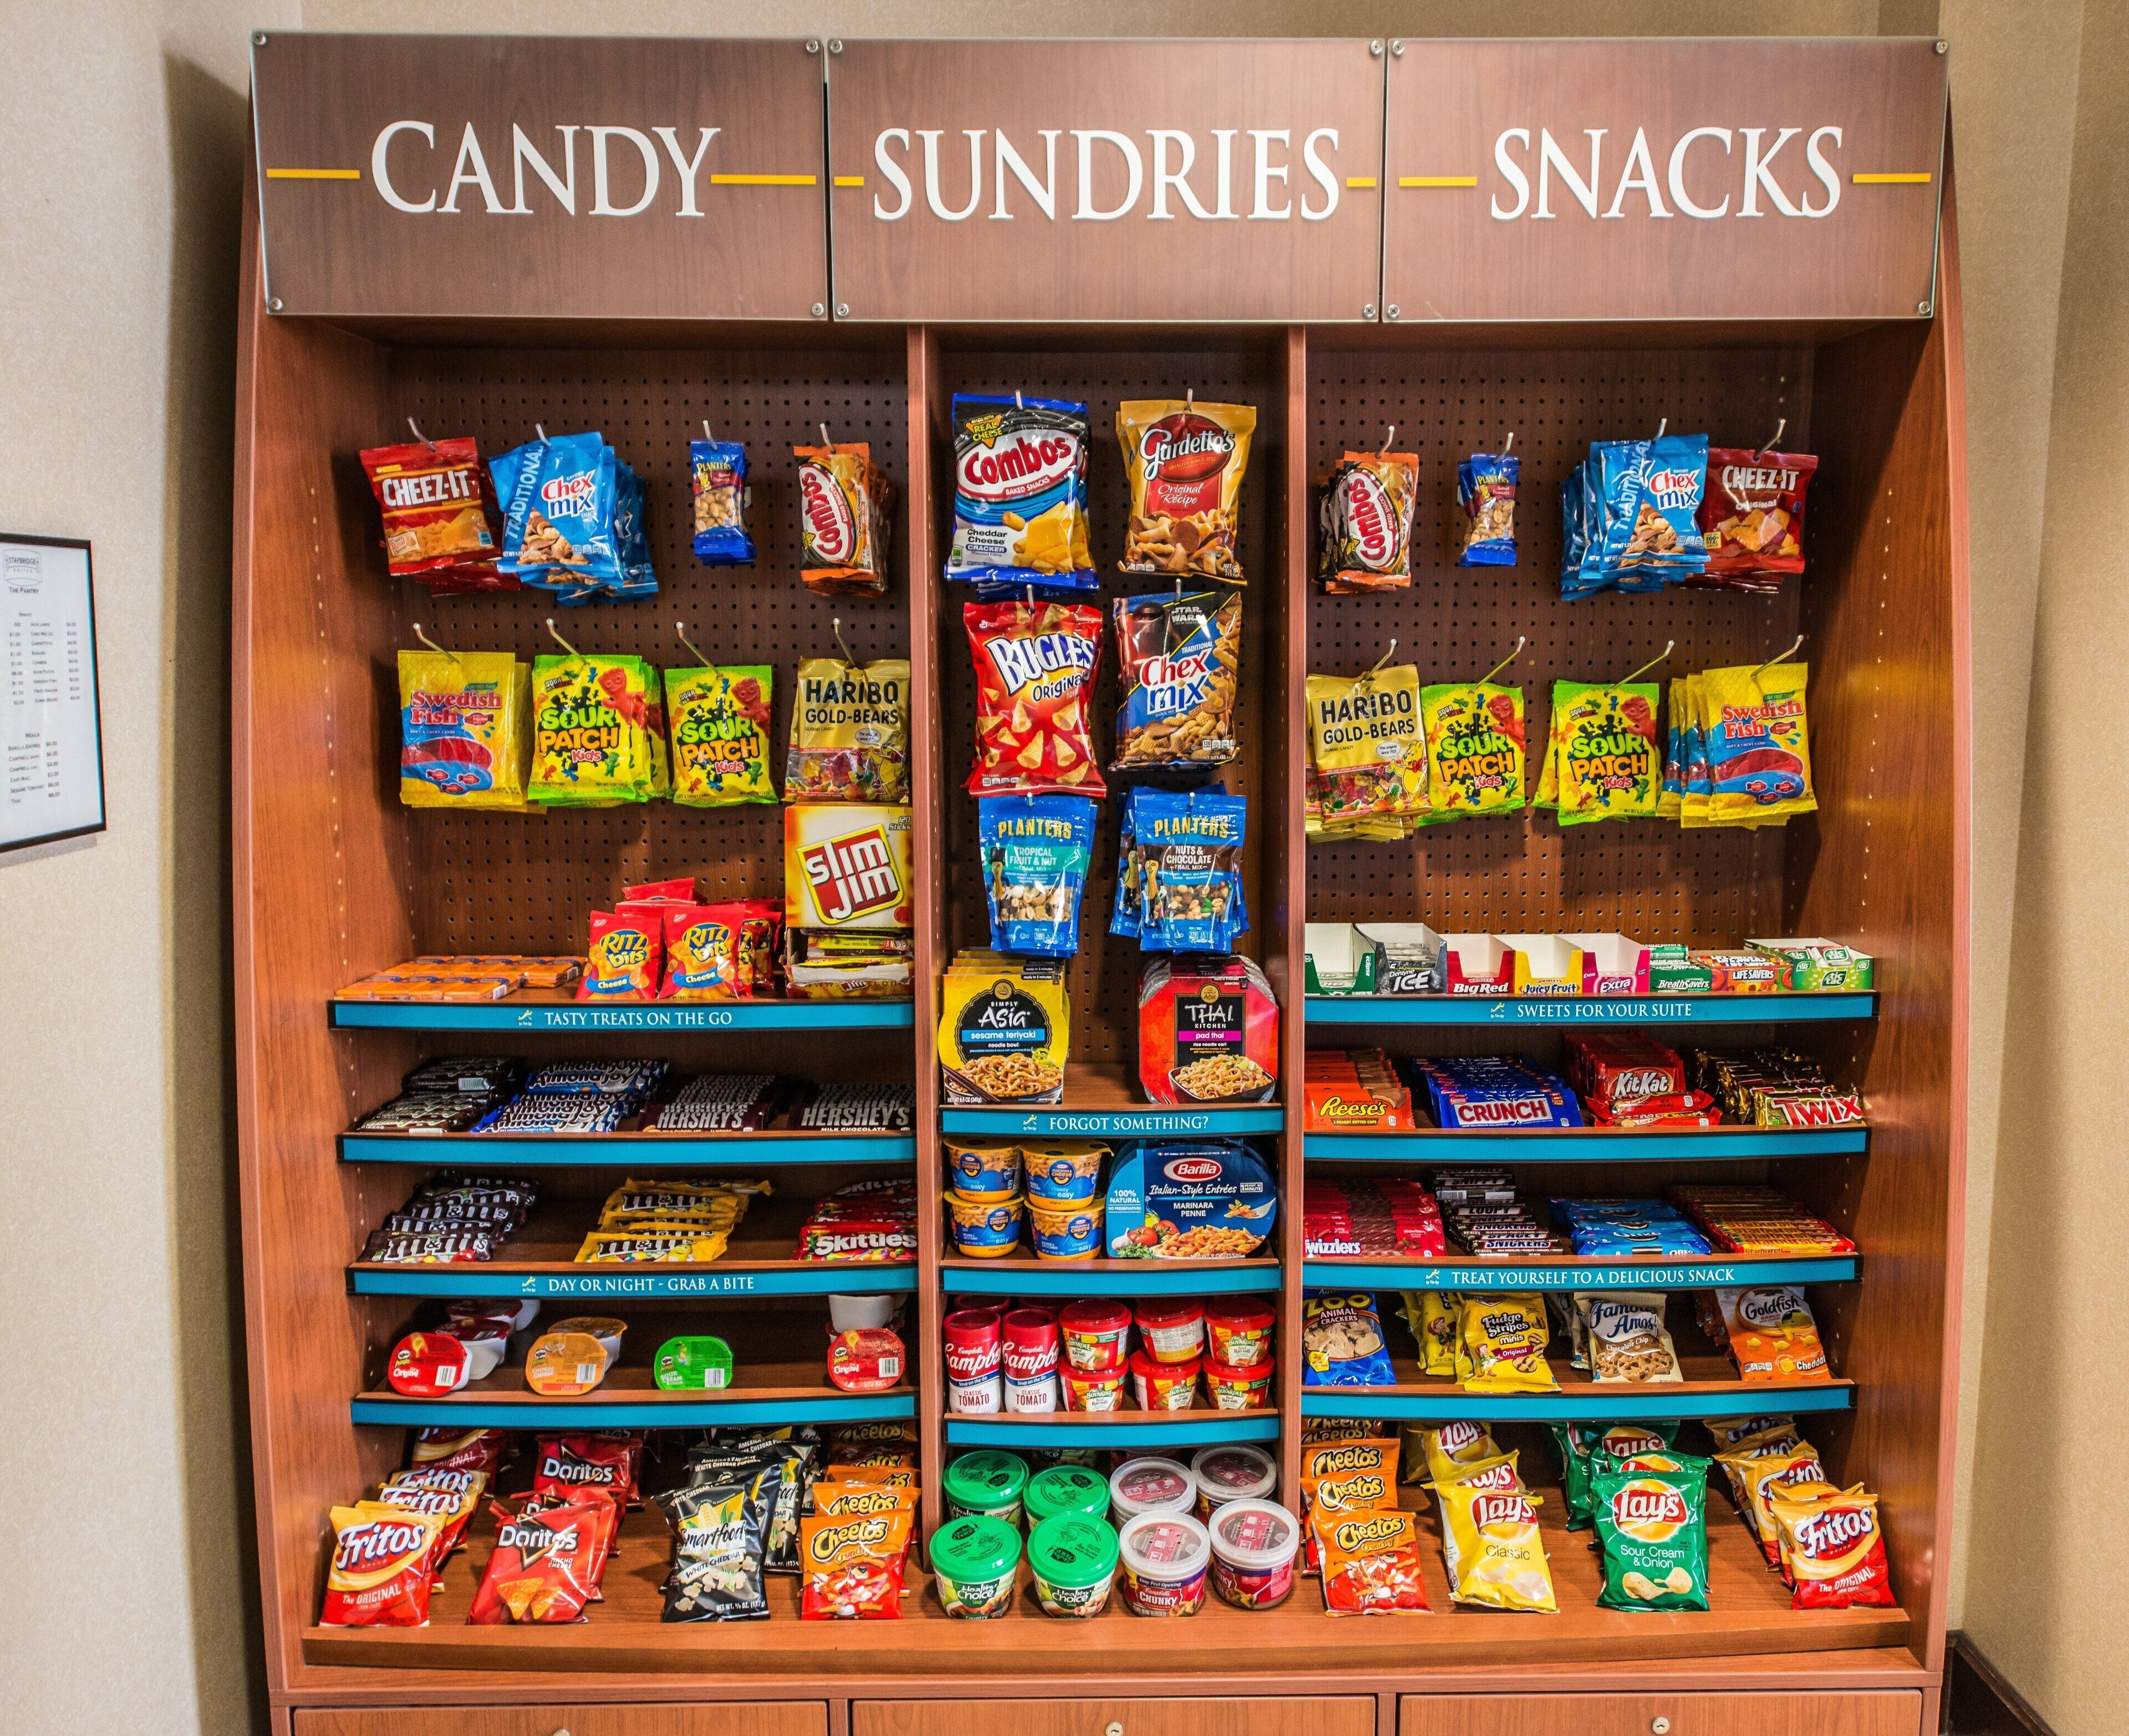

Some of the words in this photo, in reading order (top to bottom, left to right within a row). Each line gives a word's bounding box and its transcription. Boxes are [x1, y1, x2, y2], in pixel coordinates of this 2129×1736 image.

[371, 121, 721, 216] CANDY
[874, 128, 1341, 221] SUNDRIES
[1491, 125, 1842, 220] SNACKS
[972, 428, 1002, 441] CHEESE
[974, 422, 999, 434] REAL
[964, 435, 1068, 485] Combos
[1140, 429, 1236, 480] Gardetto's
[696, 462, 731, 472] PLANTERS
[383, 470, 471, 506] CHEEZ-IT
[505, 445, 544, 538] TRADITIONAL
[542, 470, 595, 500] Chex
[1158, 483, 1203, 496] Original
[549, 492, 594, 518] mix
[1164, 495, 1198, 506] Recipe
[802, 472, 843, 556] Combos
[967, 529, 1007, 538] Cheddar
[967, 536, 1005, 545] Cheese
[8, 557, 35, 565] STAYBRIDGE
[1172, 606, 1201, 615] STAR
[986, 634, 1094, 695] BUGLES
[544, 678, 562, 688] SOUR
[411, 690, 502, 708] Swedish
[806, 679, 899, 705] HARIBO
[1321, 689, 1412, 725] HARIBO
[410, 707, 458, 726] Fish
[804, 708, 899, 725] GOLD-BEARS
[538, 727, 618, 754] PATCH
[572, 749, 601, 762] Kids
[1015, 847, 1052, 857] TROPICAL
[1175, 846, 1194, 856] NUTS
[1196, 847, 1203, 855] &
[805, 837, 889, 886] slim
[1010, 856, 1031, 865] FRUIT
[1041, 857, 1057, 866] NUT
[1167, 854, 1211, 865] CHOCOLATE
[830, 866, 899, 919] jim
[600, 932, 649, 952] RITZ
[607, 950, 646, 968] bits
[1389, 969, 1415, 979] Dentyne
[1394, 971, 1431, 991] ICE
[1454, 984, 1479, 994] Big
[1481, 982, 1509, 994] Red
[1522, 984, 1550, 994] Juicy
[1551, 983, 1577, 994] Fruit
[1658, 979, 1709, 989] BreathSavers
[1517, 1004, 1571, 1017] SWEETS
[1575, 1005, 1603, 1017] FOR
[1607, 1005, 1649, 1017] YOUR
[1652, 1004, 1692, 1017] SUITE
[544, 1012, 587, 1025] TASTY
[594, 1012, 643, 1025] TREATS
[646, 1012, 670, 1025] ON
[674, 1012, 709, 1025] THE
[712, 1012, 732, 1025] GO
[979, 1008, 1026, 1029] Asia
[1006, 1030, 1036, 1040] teriyaki
[1196, 1032, 1208, 1040] pad
[1320, 1097, 1387, 1117] Reese's
[1458, 1100, 1546, 1123] CRUNCH
[657, 1111, 745, 1128] HERSHEY'S
[1050, 1117, 1109, 1130] FORGOT
[1113, 1116, 1209, 1130] SOMETHING?
[1177, 1162, 1219, 1176] Barilla
[1149, 1183, 1203, 1197] Italian-Style
[1205, 1183, 1237, 1194] Entrées
[815, 1232, 916, 1255] Skittles
[1451, 1272, 1494, 1284] TREAT
[1499, 1271, 1568, 1284] YOURSELF
[1572, 1271, 1592, 1284] TO
[1595, 1271, 1605, 1284] A
[1608, 1270, 1685, 1284] DELICIOUS
[1689, 1269, 1735, 1281] SNACK
[548, 1279, 576, 1291] DAY
[580, 1279, 603, 1291] OR
[605, 1279, 655, 1291] NIGHT
[668, 1278, 706, 1291] GRAB
[710, 1279, 719, 1290] A
[723, 1277, 754, 1290] BITE
[1320, 1309, 1357, 1318] ANIMAL
[1746, 1295, 1801, 1320] Goldfish
[1321, 1315, 1358, 1325] CRACKERS
[1482, 1313, 1522, 1326] Fudge
[1488, 1322, 1530, 1338] Stripes
[1499, 1334, 1524, 1345] minis
[1606, 1341, 1635, 1352] Chocolate
[958, 1346, 984, 1355] Campbell's
[958, 1394, 989, 1407] TOMATO
[543, 1458, 614, 1483] Doritos
[1793, 1506, 1875, 1559] Fritos
[336, 1523, 425, 1571] Fritos
[814, 1520, 889, 1560] Cheetos
[1485, 1545, 1531, 1561] Classic
[1620, 1545, 1646, 1557] Sour
[1648, 1546, 1685, 1559] Cream
[686, 1562, 709, 1578] WHITE
[710, 1551, 741, 1567] CHEDDAR
[1633, 1557, 1641, 1566] &
[1642, 1557, 1674, 1568] Onion
[343, 1595, 355, 1604] The
[356, 1585, 401, 1604] ORIGINAL
[956, 1587, 995, 1600] Choice
[1140, 1595, 1178, 1607] CHUNKY
